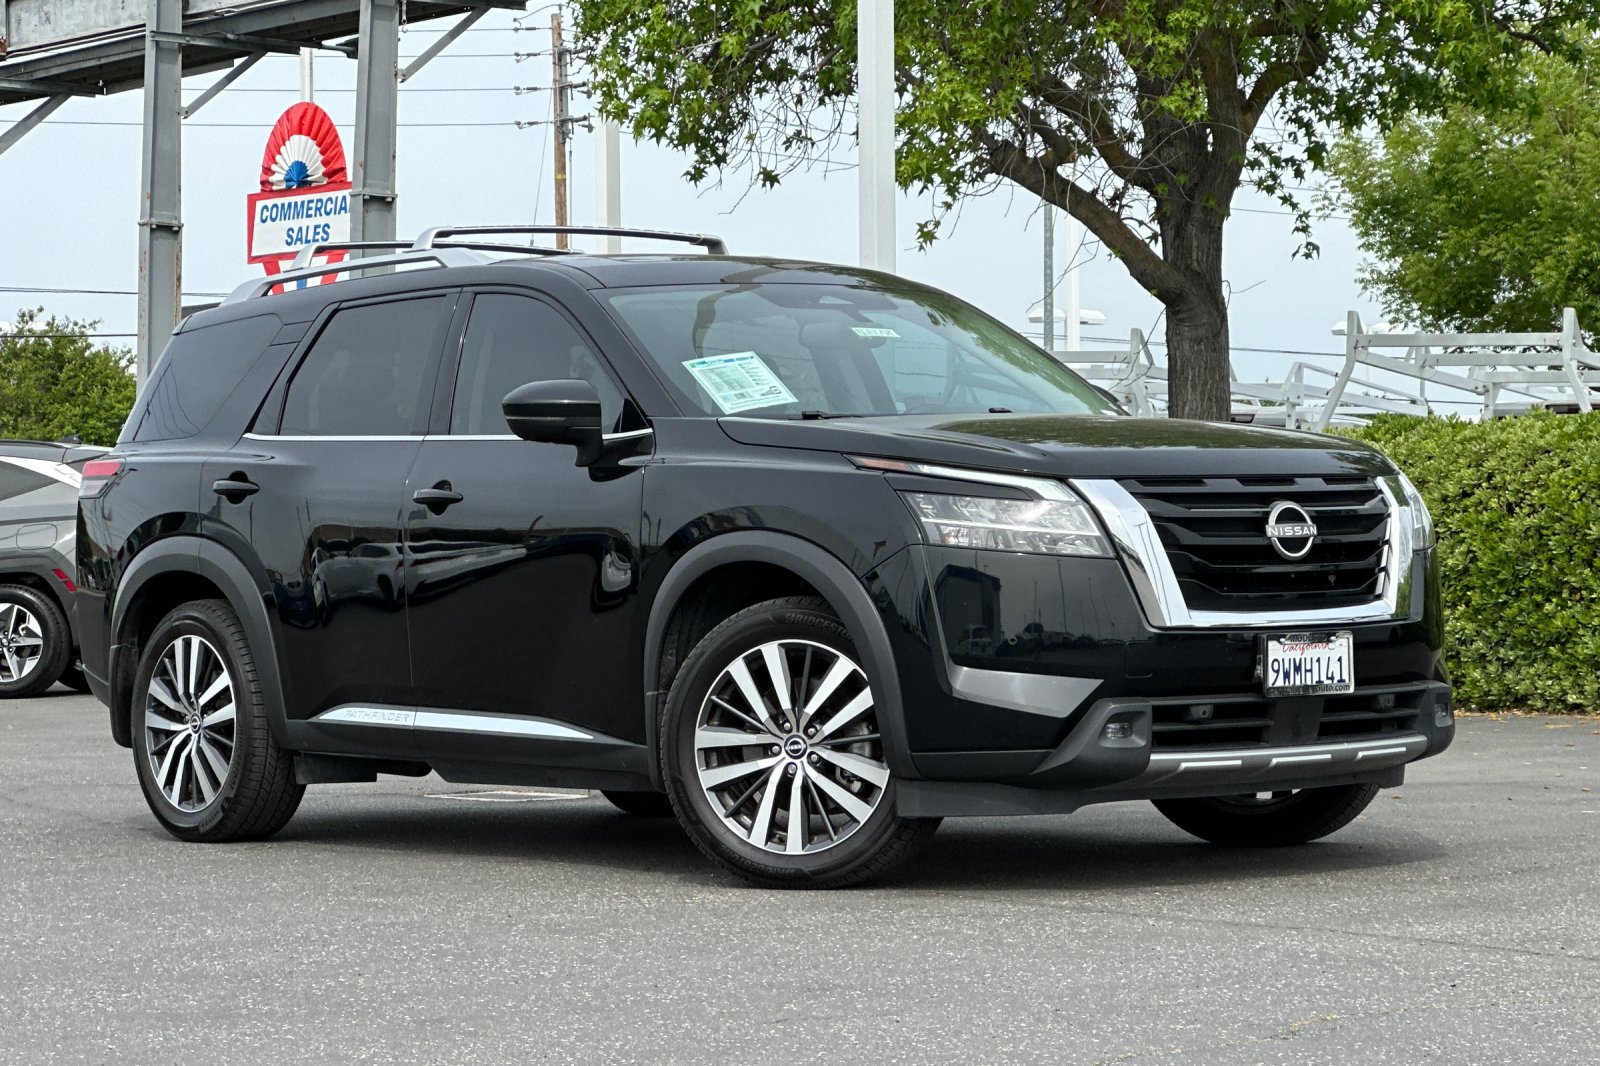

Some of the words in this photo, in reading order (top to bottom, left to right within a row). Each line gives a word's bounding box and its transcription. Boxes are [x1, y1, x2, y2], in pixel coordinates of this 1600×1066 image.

[260, 195, 351, 224] COMMERCIA
[285, 223, 331, 247] SALES
[1268, 526, 1317, 536] NISSAN
[784, 612, 852, 641] BRIDGESTO
[1283, 642, 1335, 656] California
[1271, 656, 1346, 686] 9WMH141
[344, 709, 410, 722] PATHFINDER
